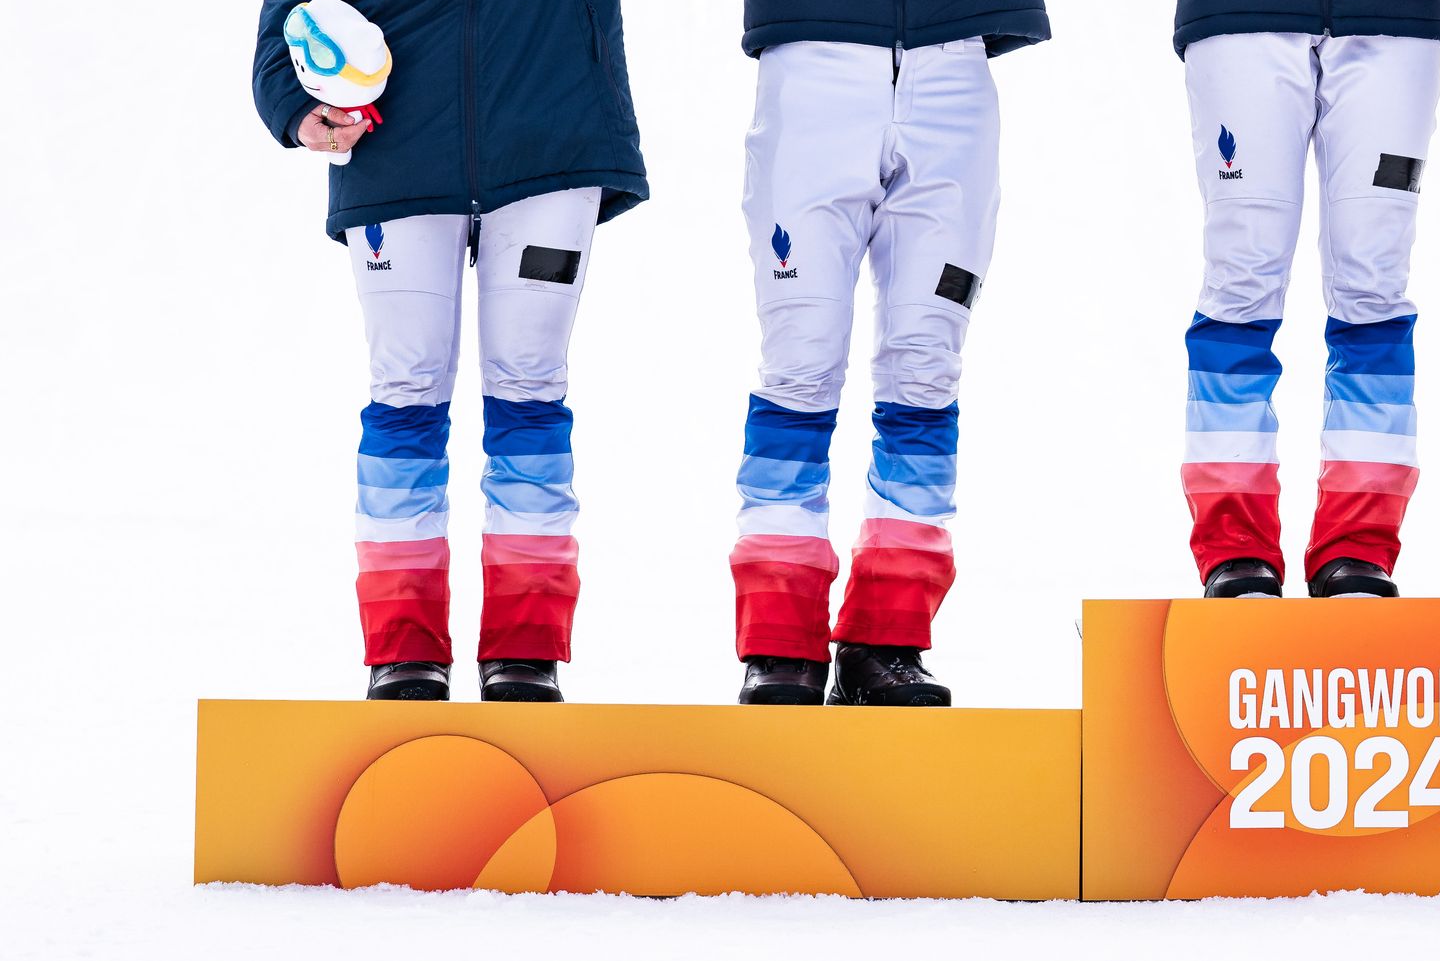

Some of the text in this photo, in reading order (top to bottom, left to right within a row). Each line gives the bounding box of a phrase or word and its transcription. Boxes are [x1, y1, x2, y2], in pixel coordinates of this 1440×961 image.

[1219, 169, 1243, 180] FRANCE
[367, 259, 392, 271] FRANCE
[774, 268, 798, 280] FRANCE
